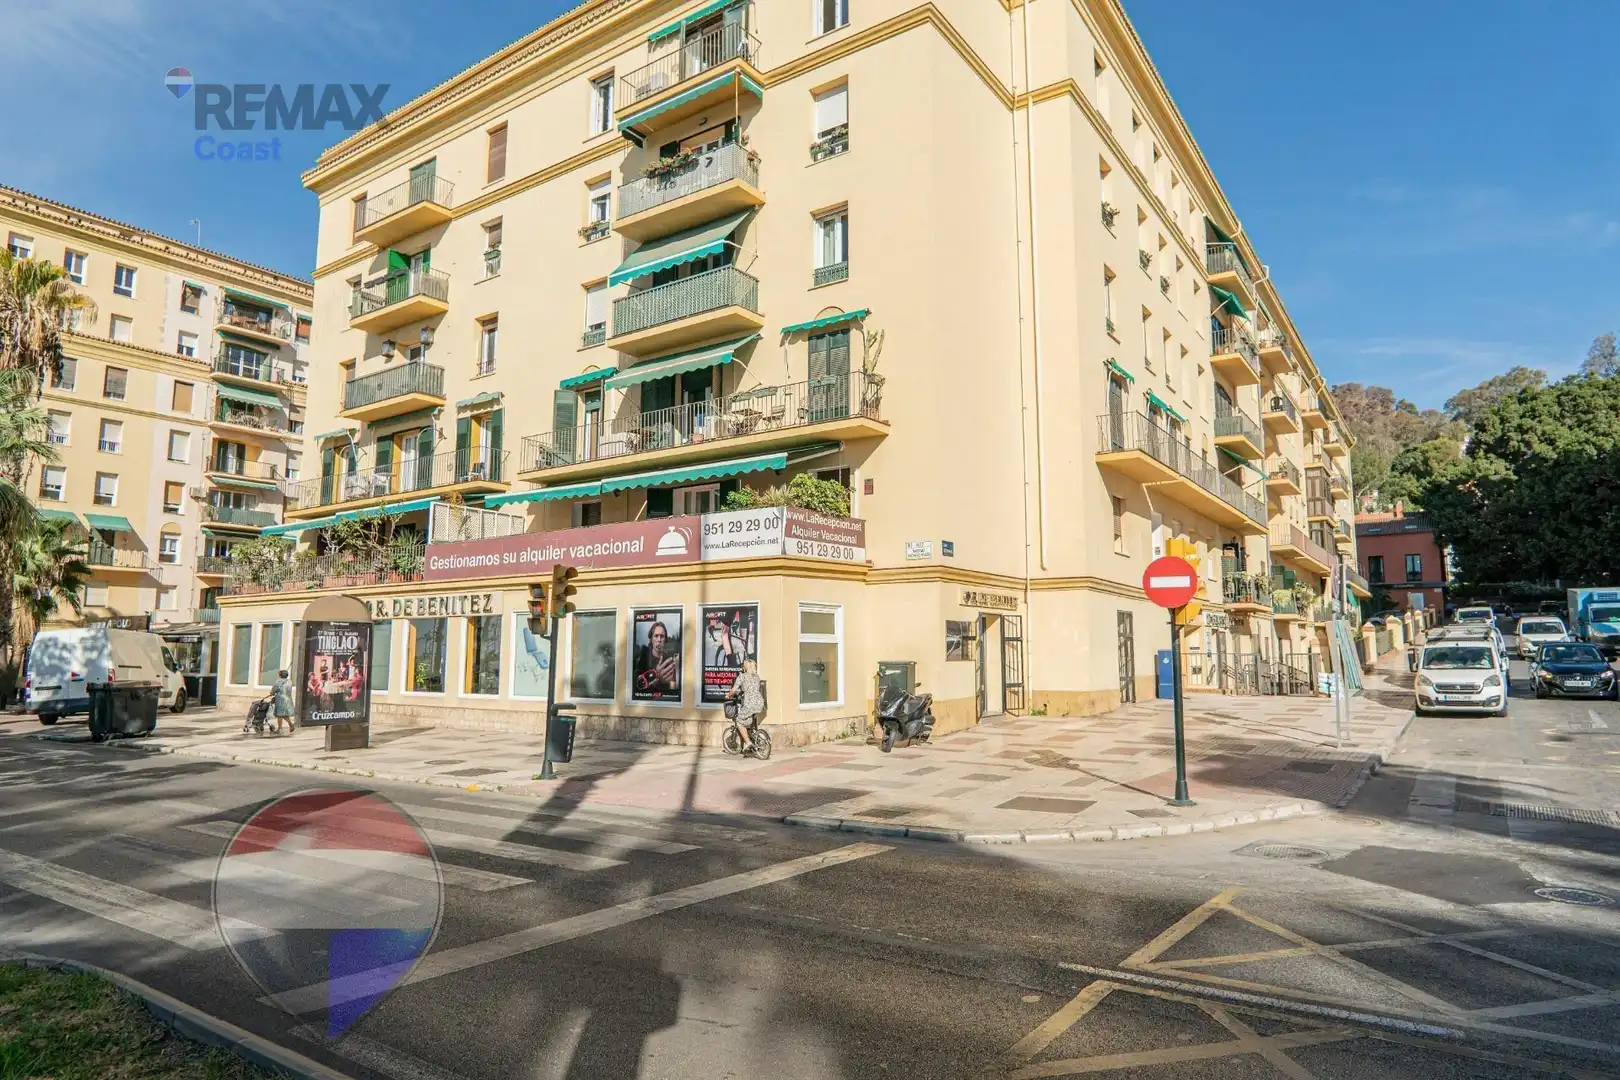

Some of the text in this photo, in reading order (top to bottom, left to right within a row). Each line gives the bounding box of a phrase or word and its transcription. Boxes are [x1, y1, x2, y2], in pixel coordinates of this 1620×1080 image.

[704, 517, 780, 536] 951 29 29 00
[791, 524, 858, 544] Alquiler Vacacional
[430, 536, 645, 570] Gestionamos su alquiler vacacional
[796, 540, 854, 560] 951 29 29 00
[416, 594, 494, 616] BENITEZ
[312, 711, 355, 720] Cruzcampo
